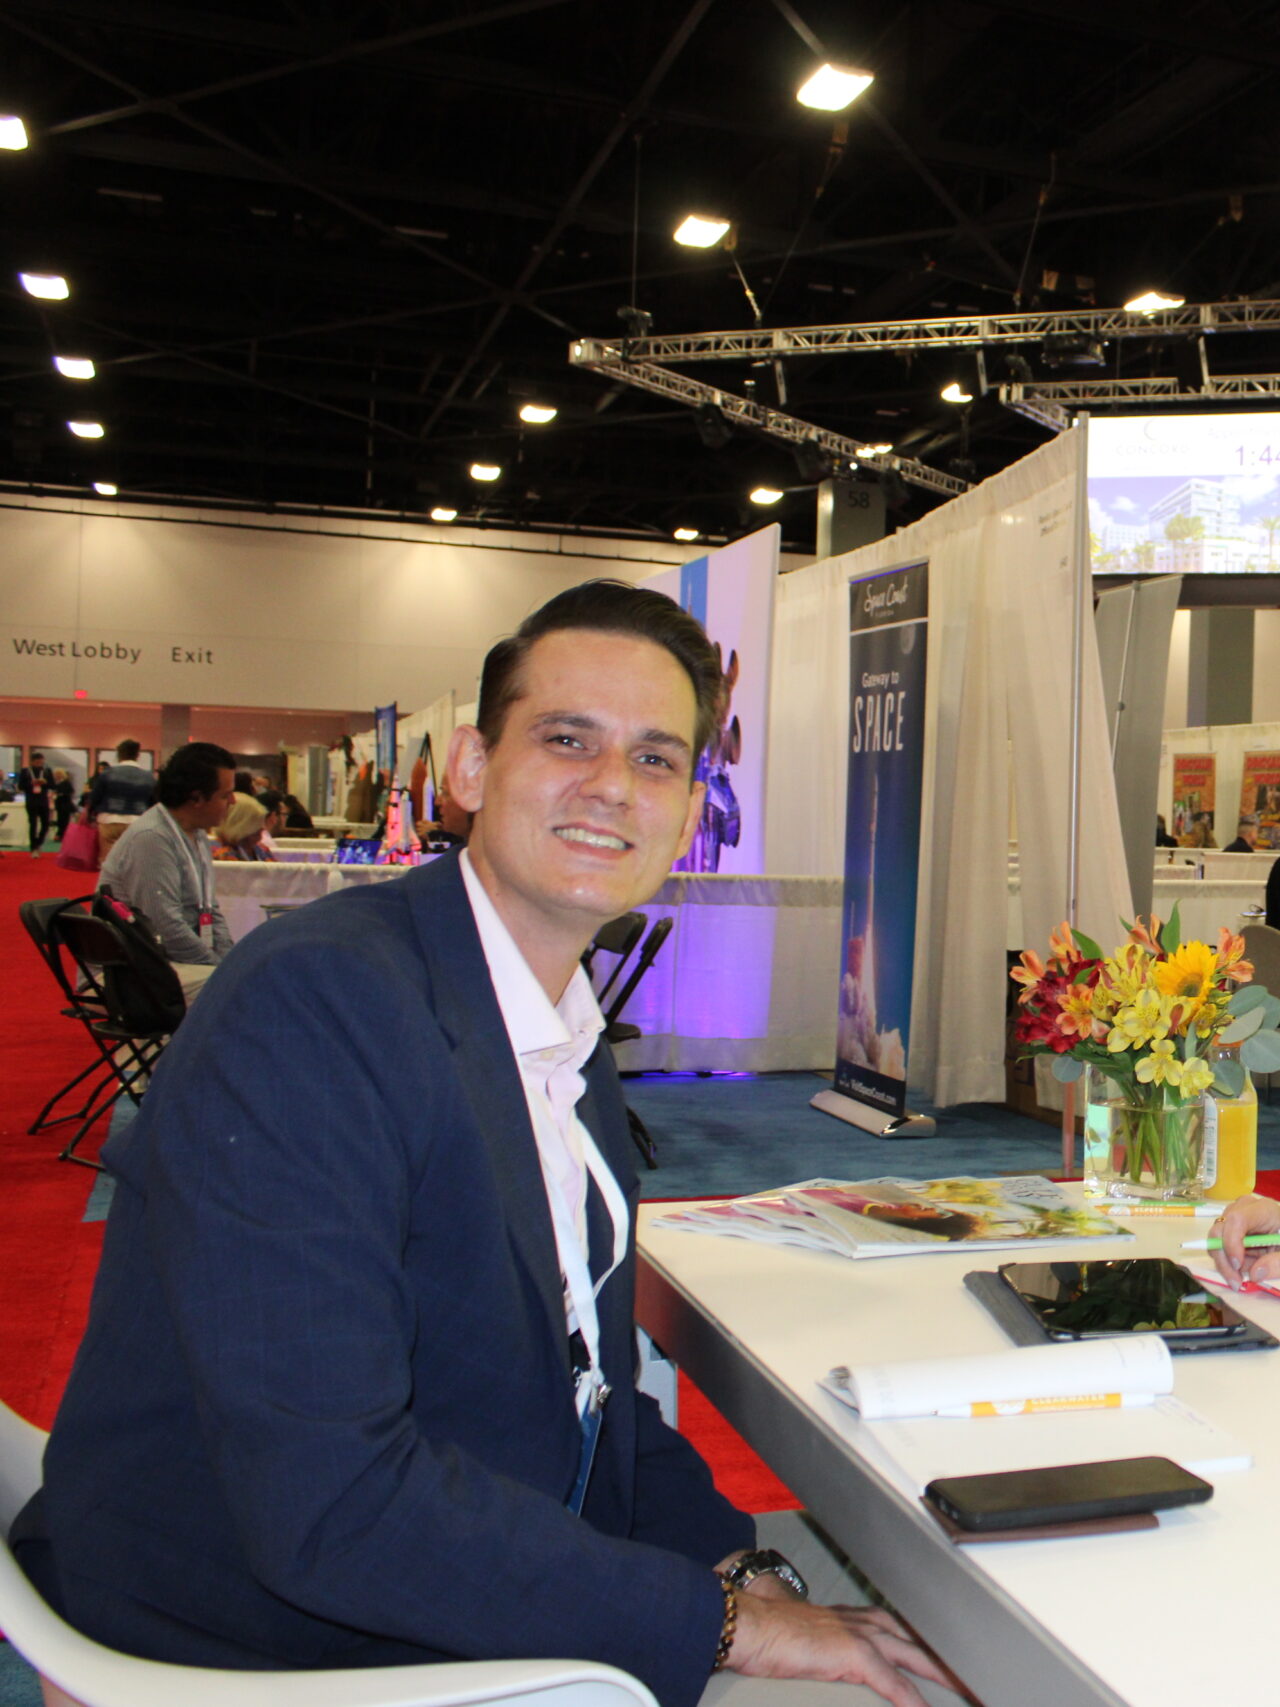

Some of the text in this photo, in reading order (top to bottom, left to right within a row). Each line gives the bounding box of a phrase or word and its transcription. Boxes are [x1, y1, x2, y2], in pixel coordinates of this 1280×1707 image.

[848, 490, 870, 509] 58
[12, 638, 142, 665] West Lobby
[171, 646, 214, 665] Exit
[861, 671, 900, 689] Gateway to
[853, 691, 906, 753] SPACE
